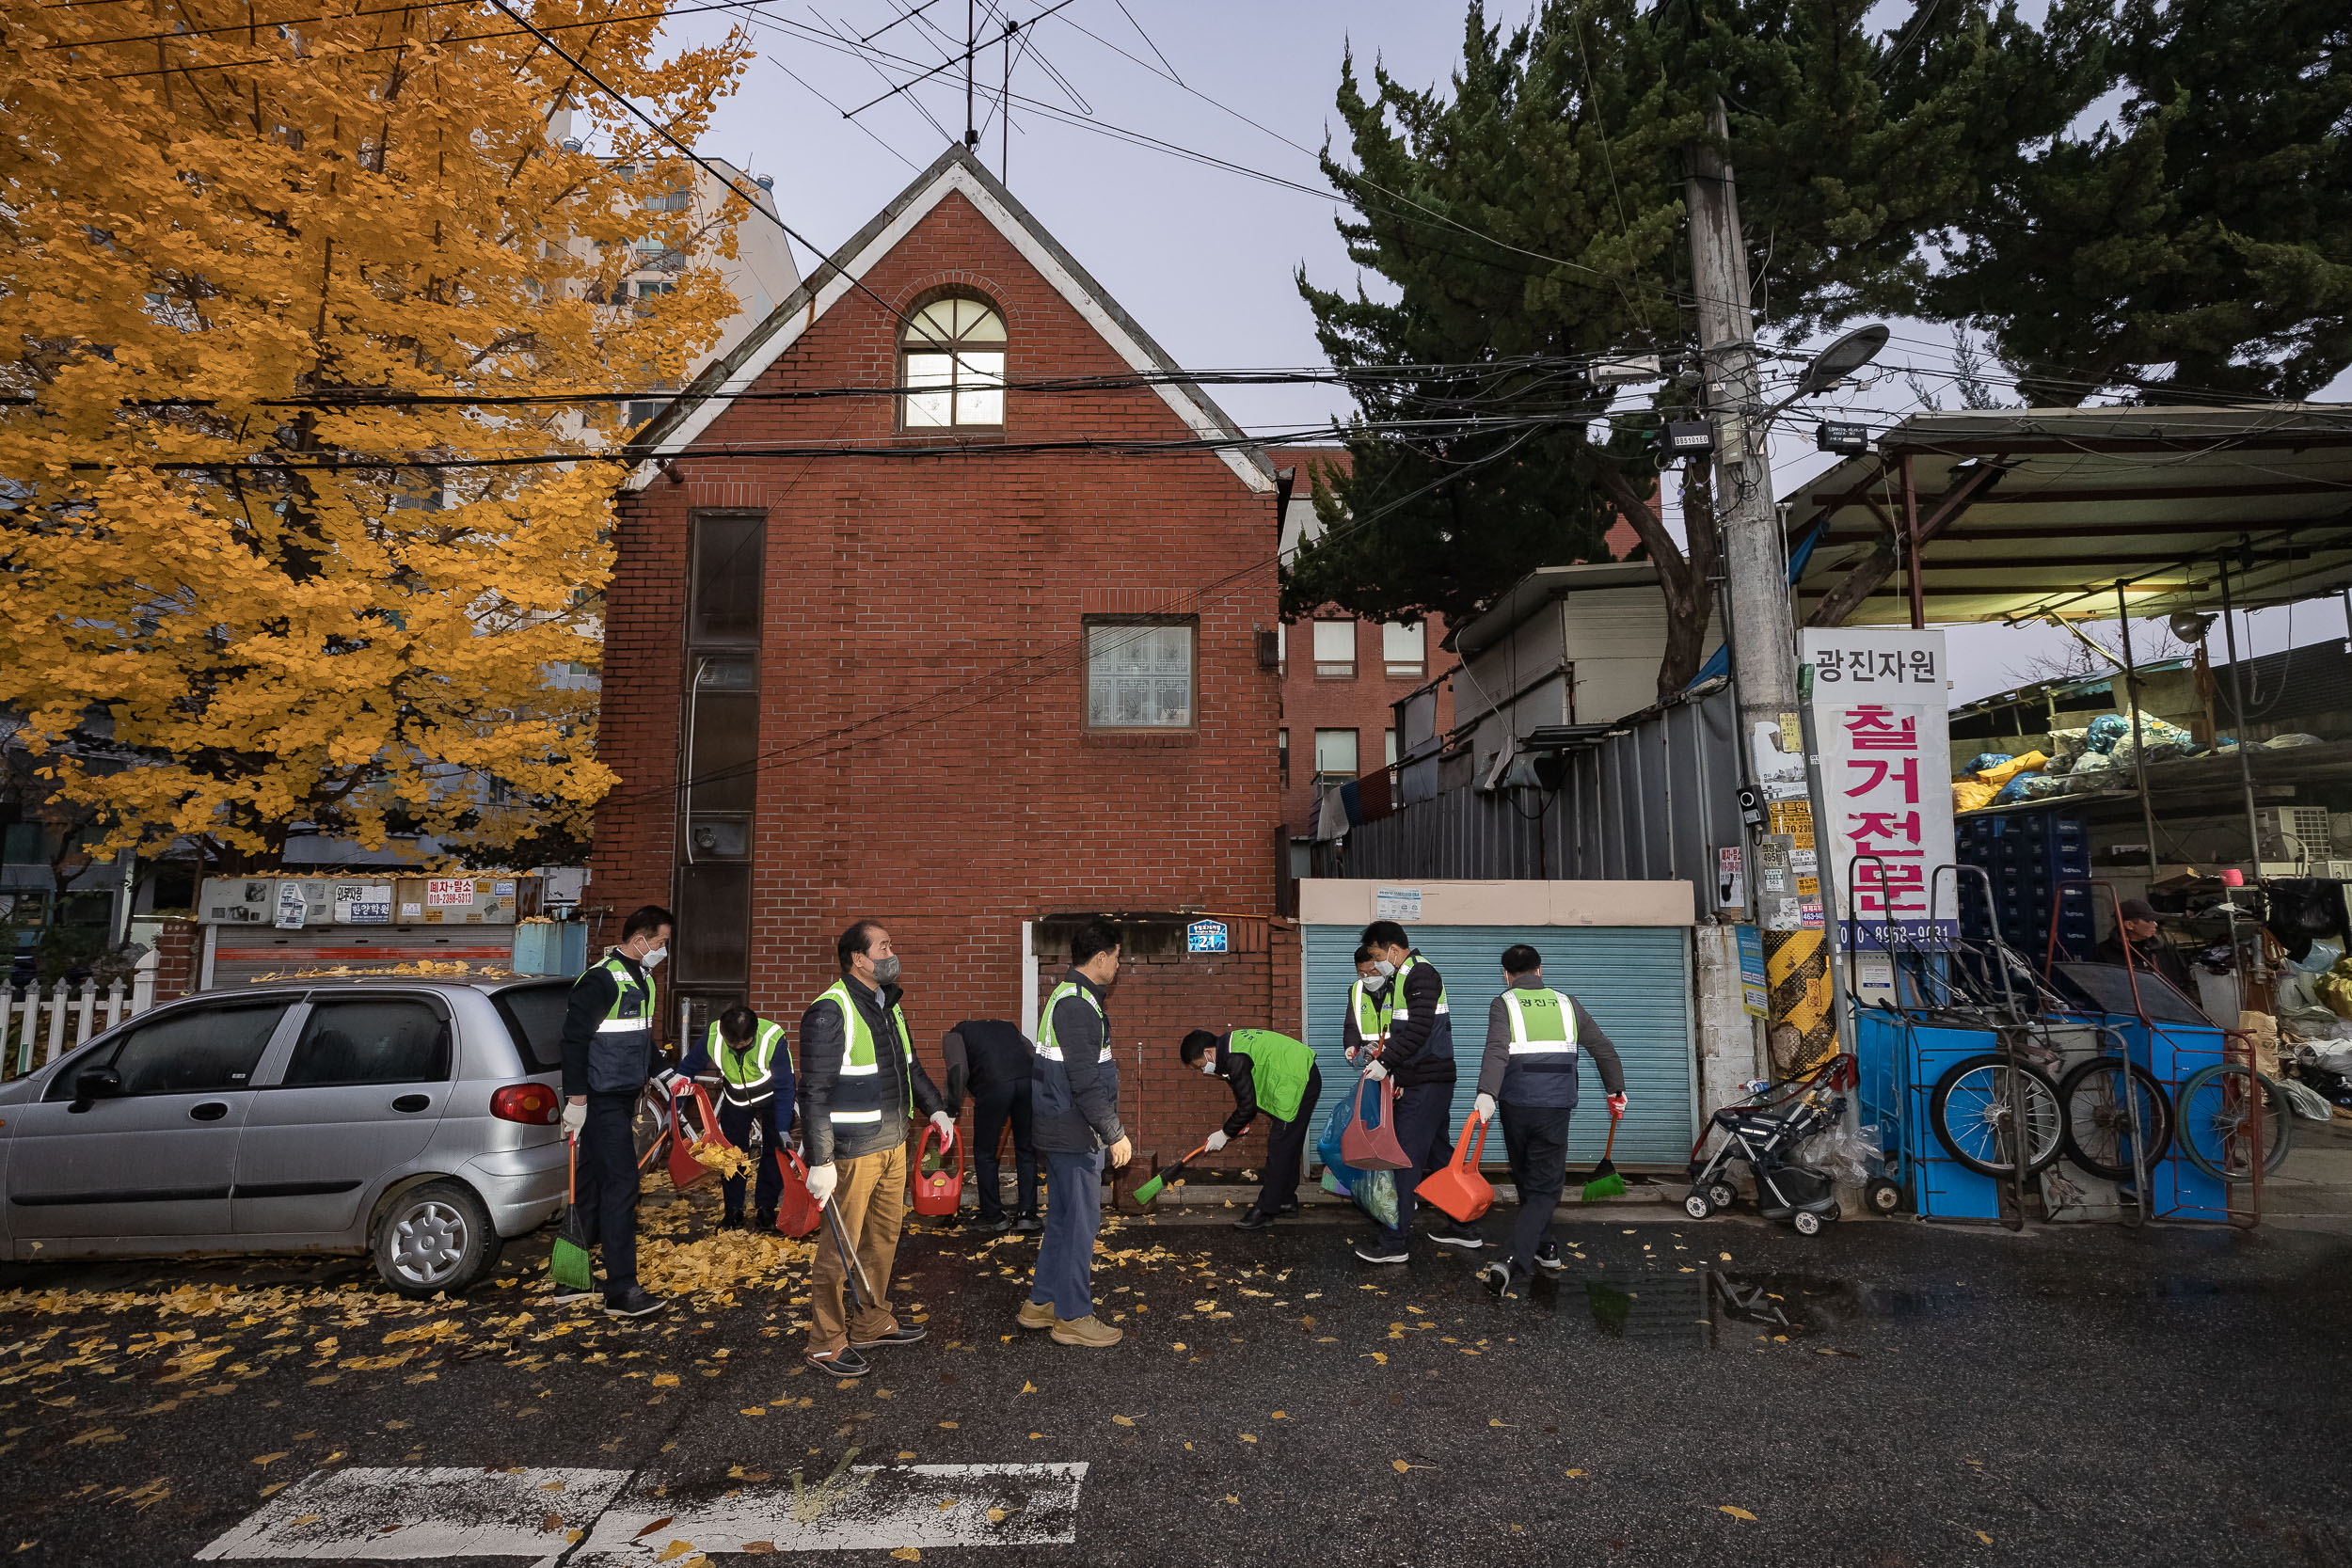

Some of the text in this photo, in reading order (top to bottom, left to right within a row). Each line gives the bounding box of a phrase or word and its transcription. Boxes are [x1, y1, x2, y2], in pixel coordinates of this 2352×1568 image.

[1816, 649, 1936, 684] 광진자원
[429, 880, 471, 893] 폐차+말소
[429, 893, 471, 904] 010-2398-5313
[352, 903, 389, 915] 한양학원
[1199, 935, 1215, 948] 21
[1519, 998, 1559, 1007] 광진구
